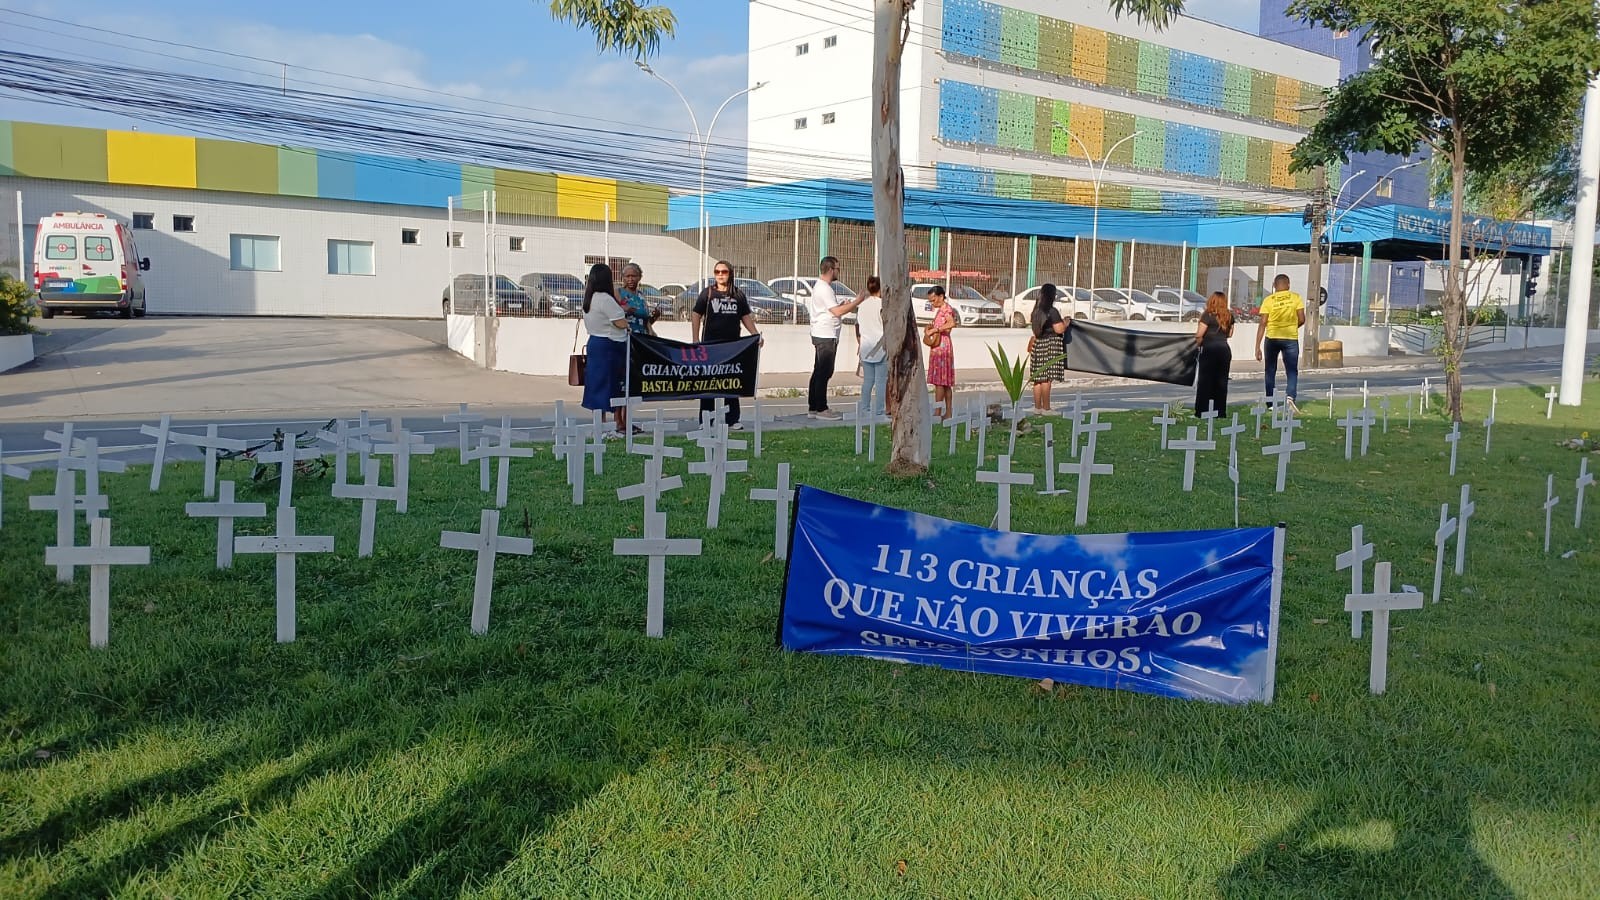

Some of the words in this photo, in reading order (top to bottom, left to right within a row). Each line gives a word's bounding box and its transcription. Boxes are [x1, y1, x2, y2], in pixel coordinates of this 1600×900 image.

[53, 222, 104, 230] AMBULÂNCIA
[1398, 214, 1435, 234] NOVO
[681, 345, 709, 362] 113
[642, 363, 700, 379] CRIANÇAS
[701, 363, 743, 376] MORTAS.
[641, 380, 674, 393] BASTA
[676, 380, 693, 391] DE
[692, 377, 743, 391] SILÊNCIO.
[872, 544, 939, 582] 113
[948, 559, 1159, 609] CRIANÇAS
[823, 578, 905, 621] QUE
[911, 594, 999, 637] NÃO
[1009, 605, 1202, 641] VIVERÃO
[967, 646, 1153, 675] SONHOS.
